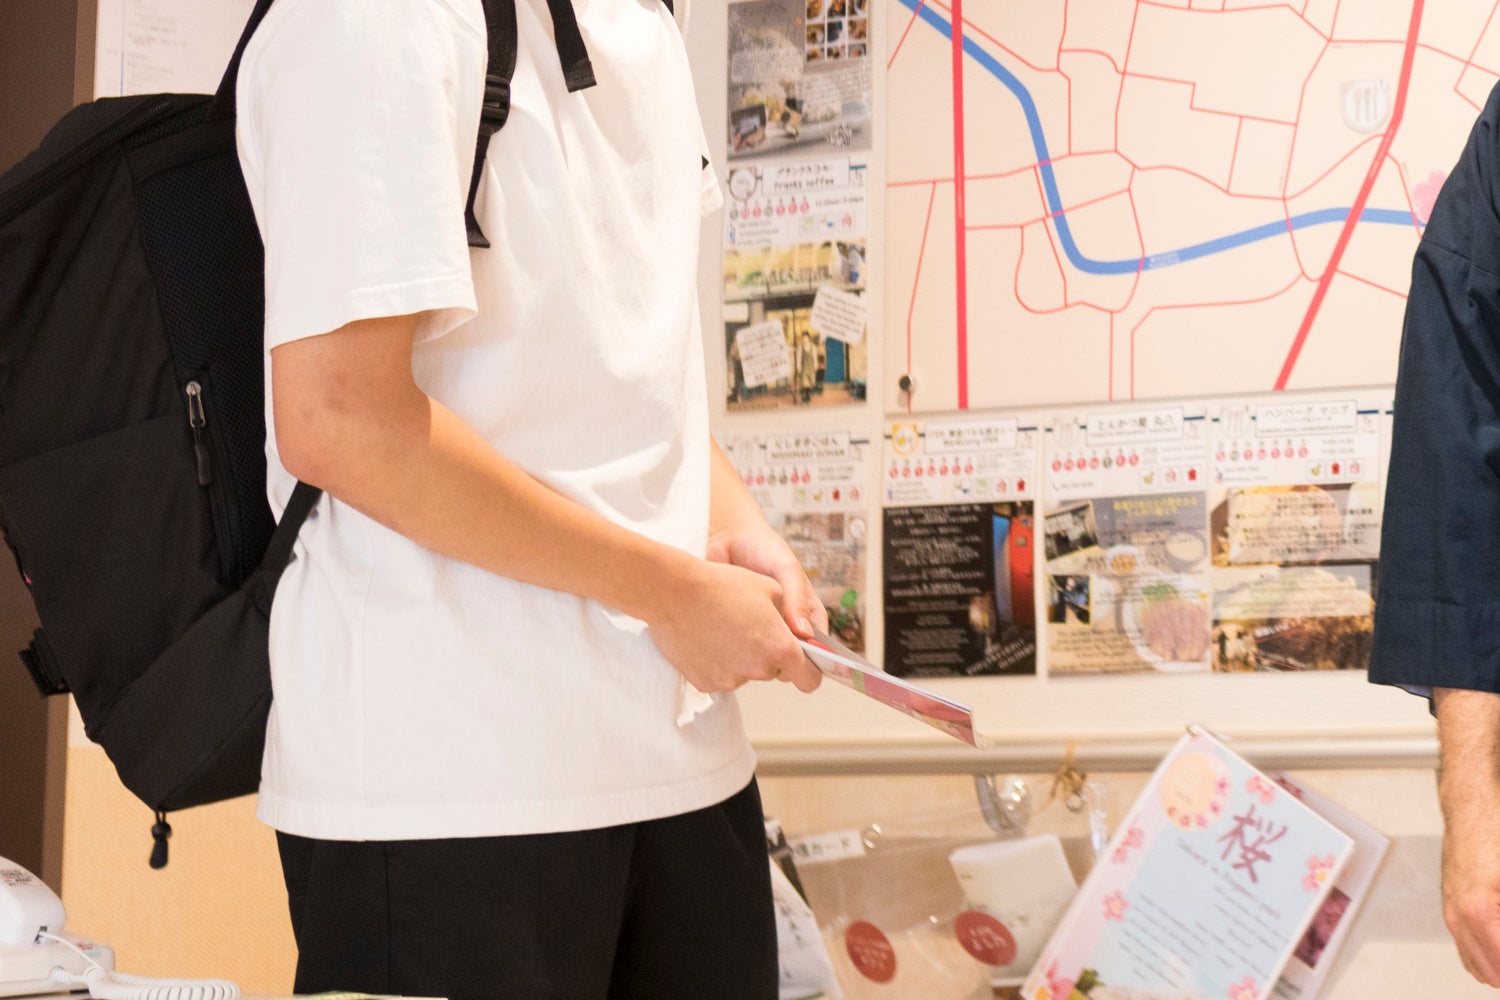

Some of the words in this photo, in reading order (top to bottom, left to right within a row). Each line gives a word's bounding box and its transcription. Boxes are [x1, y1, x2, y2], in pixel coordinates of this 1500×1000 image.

[1320, 405, 1350, 415] マニア
[1216, 803, 1289, 884] 桜
